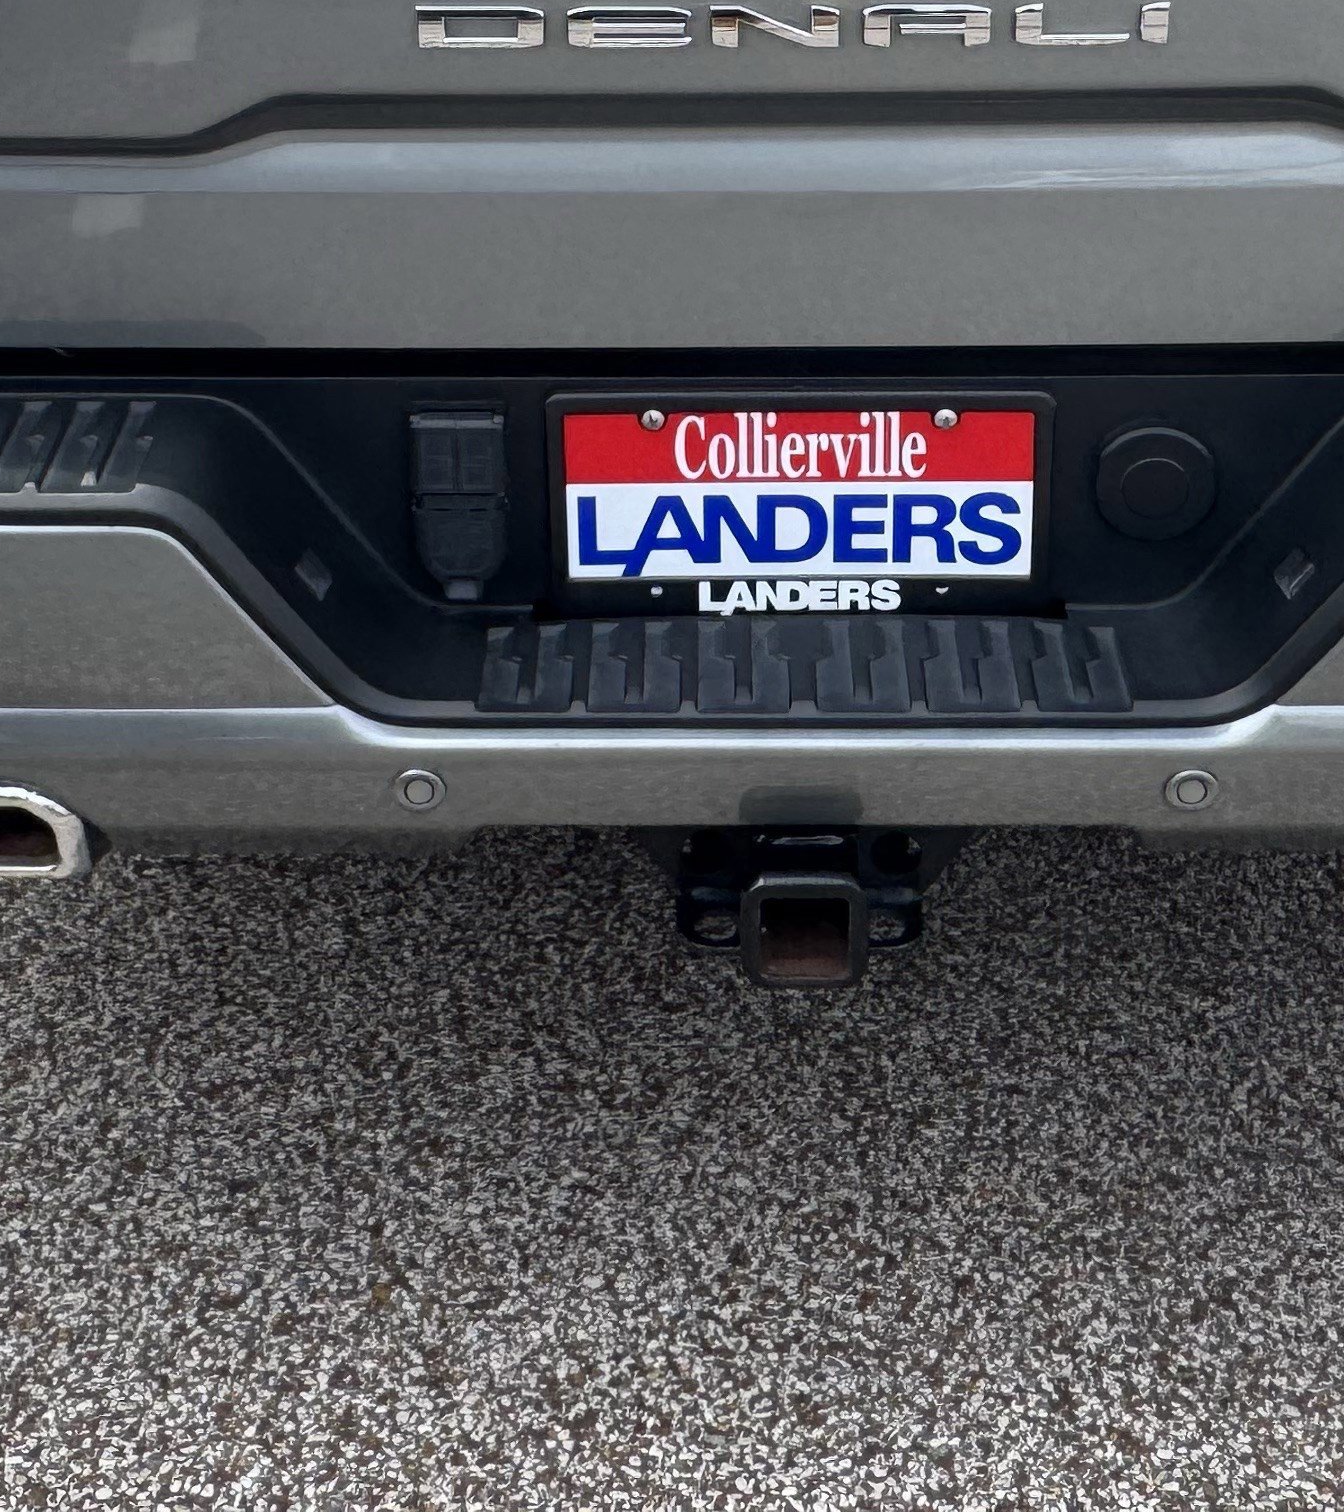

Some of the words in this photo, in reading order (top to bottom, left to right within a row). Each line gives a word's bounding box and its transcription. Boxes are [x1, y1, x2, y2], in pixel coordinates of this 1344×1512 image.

[415, 1, 1171, 49] DENALI
[674, 412, 927, 480] Collierville
[577, 492, 1022, 576] LANDERS
[699, 579, 901, 616] LANDERS
